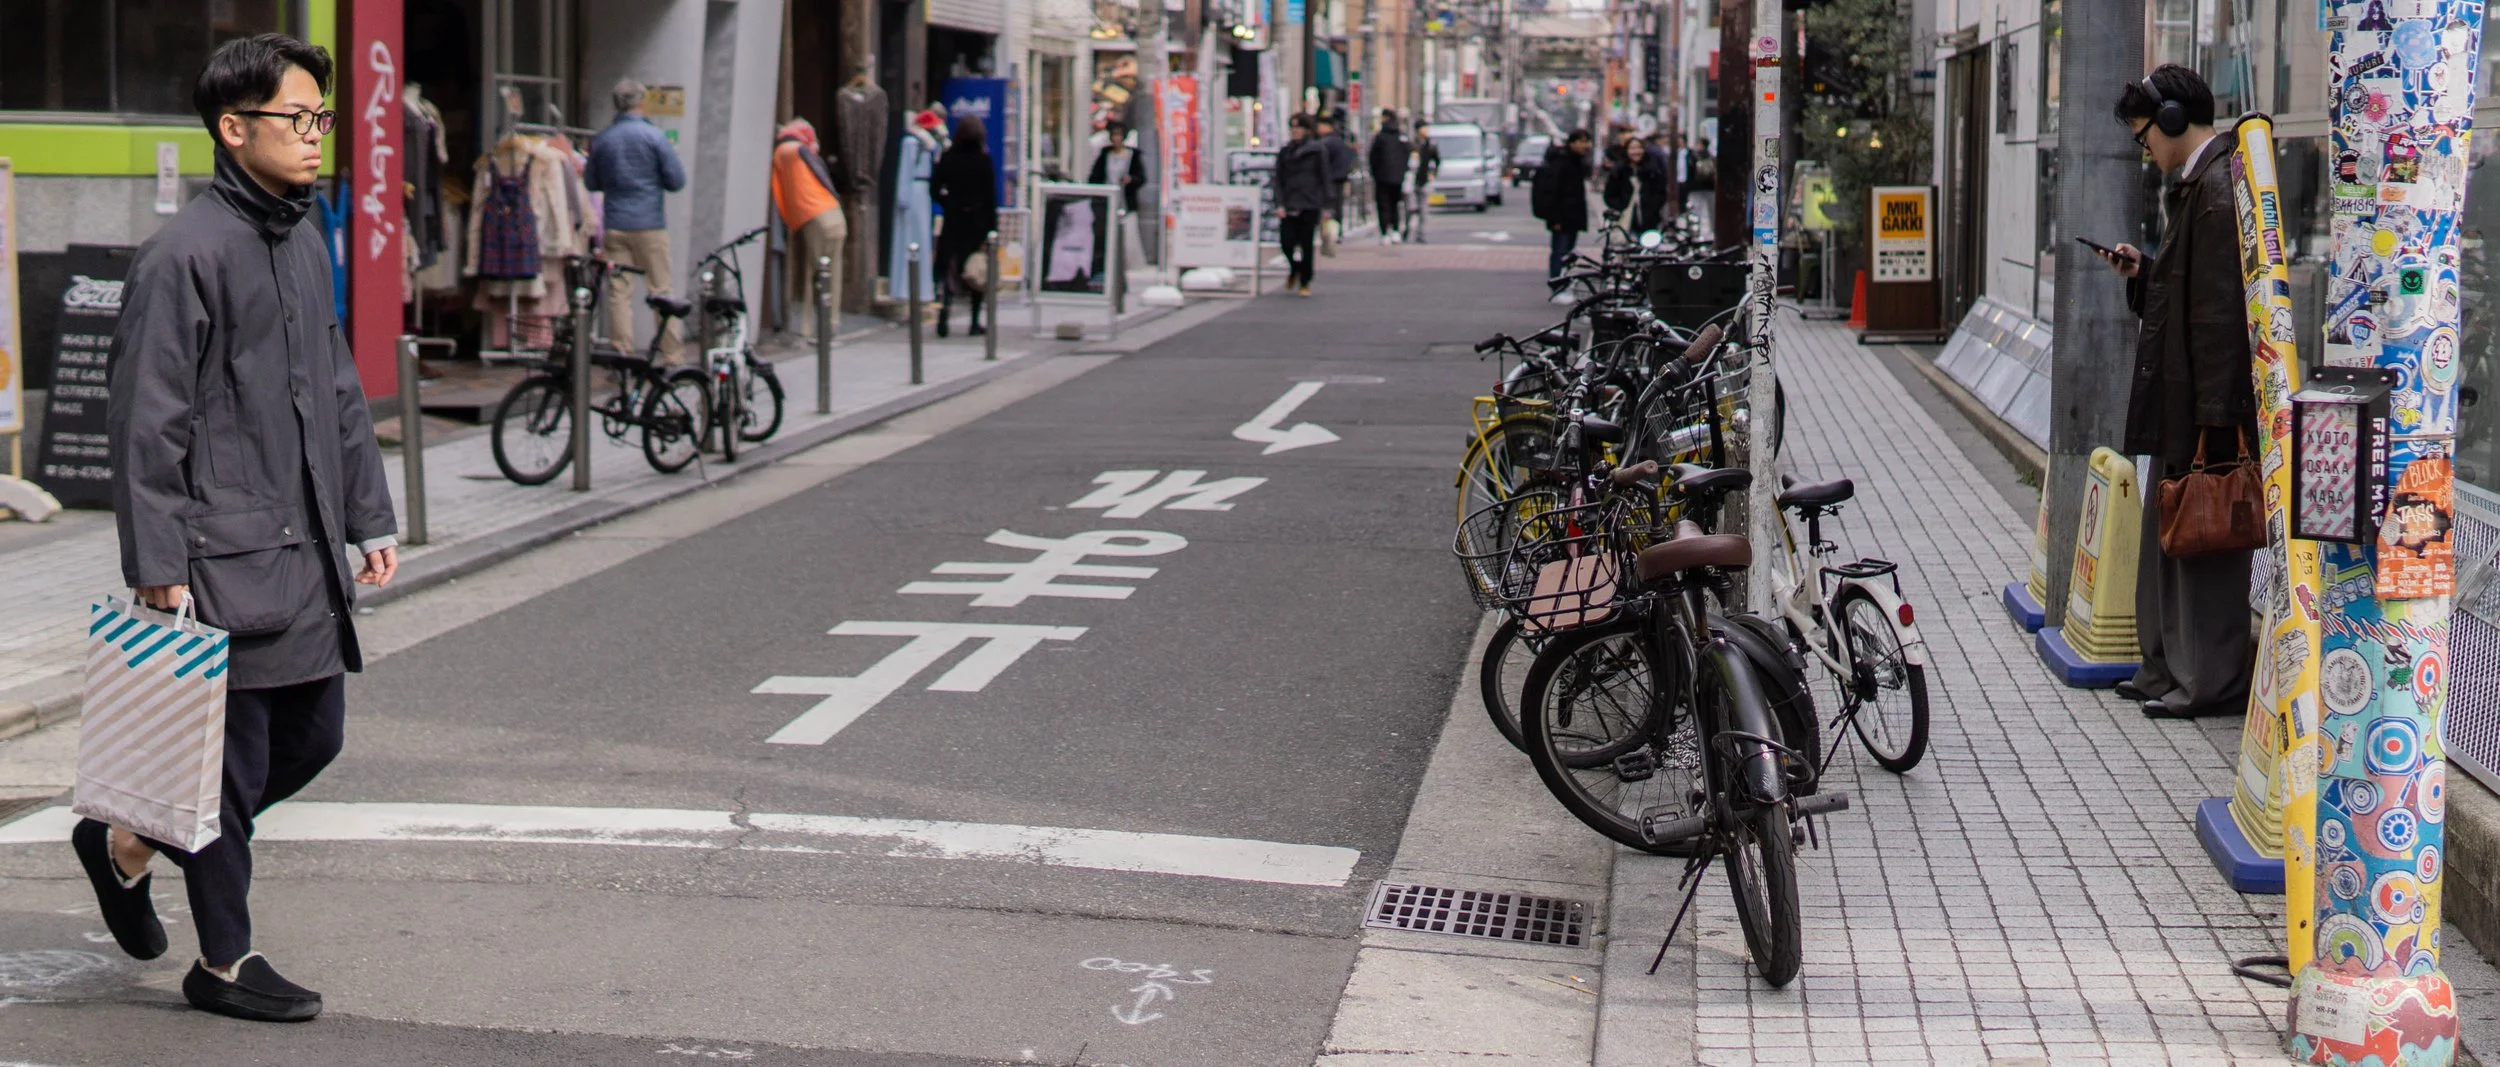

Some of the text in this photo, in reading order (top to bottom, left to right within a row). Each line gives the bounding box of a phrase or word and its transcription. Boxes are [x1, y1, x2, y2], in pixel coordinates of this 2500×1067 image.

[1887, 201, 1918, 216] MIKI
[1882, 216, 1923, 231] GAKKI
[2307, 430, 2350, 446] KYOTO
[2306, 459, 2350, 475] OSAKA
[2371, 417, 2386, 528] FREE MAP
[2309, 489, 2345, 505] NARA
